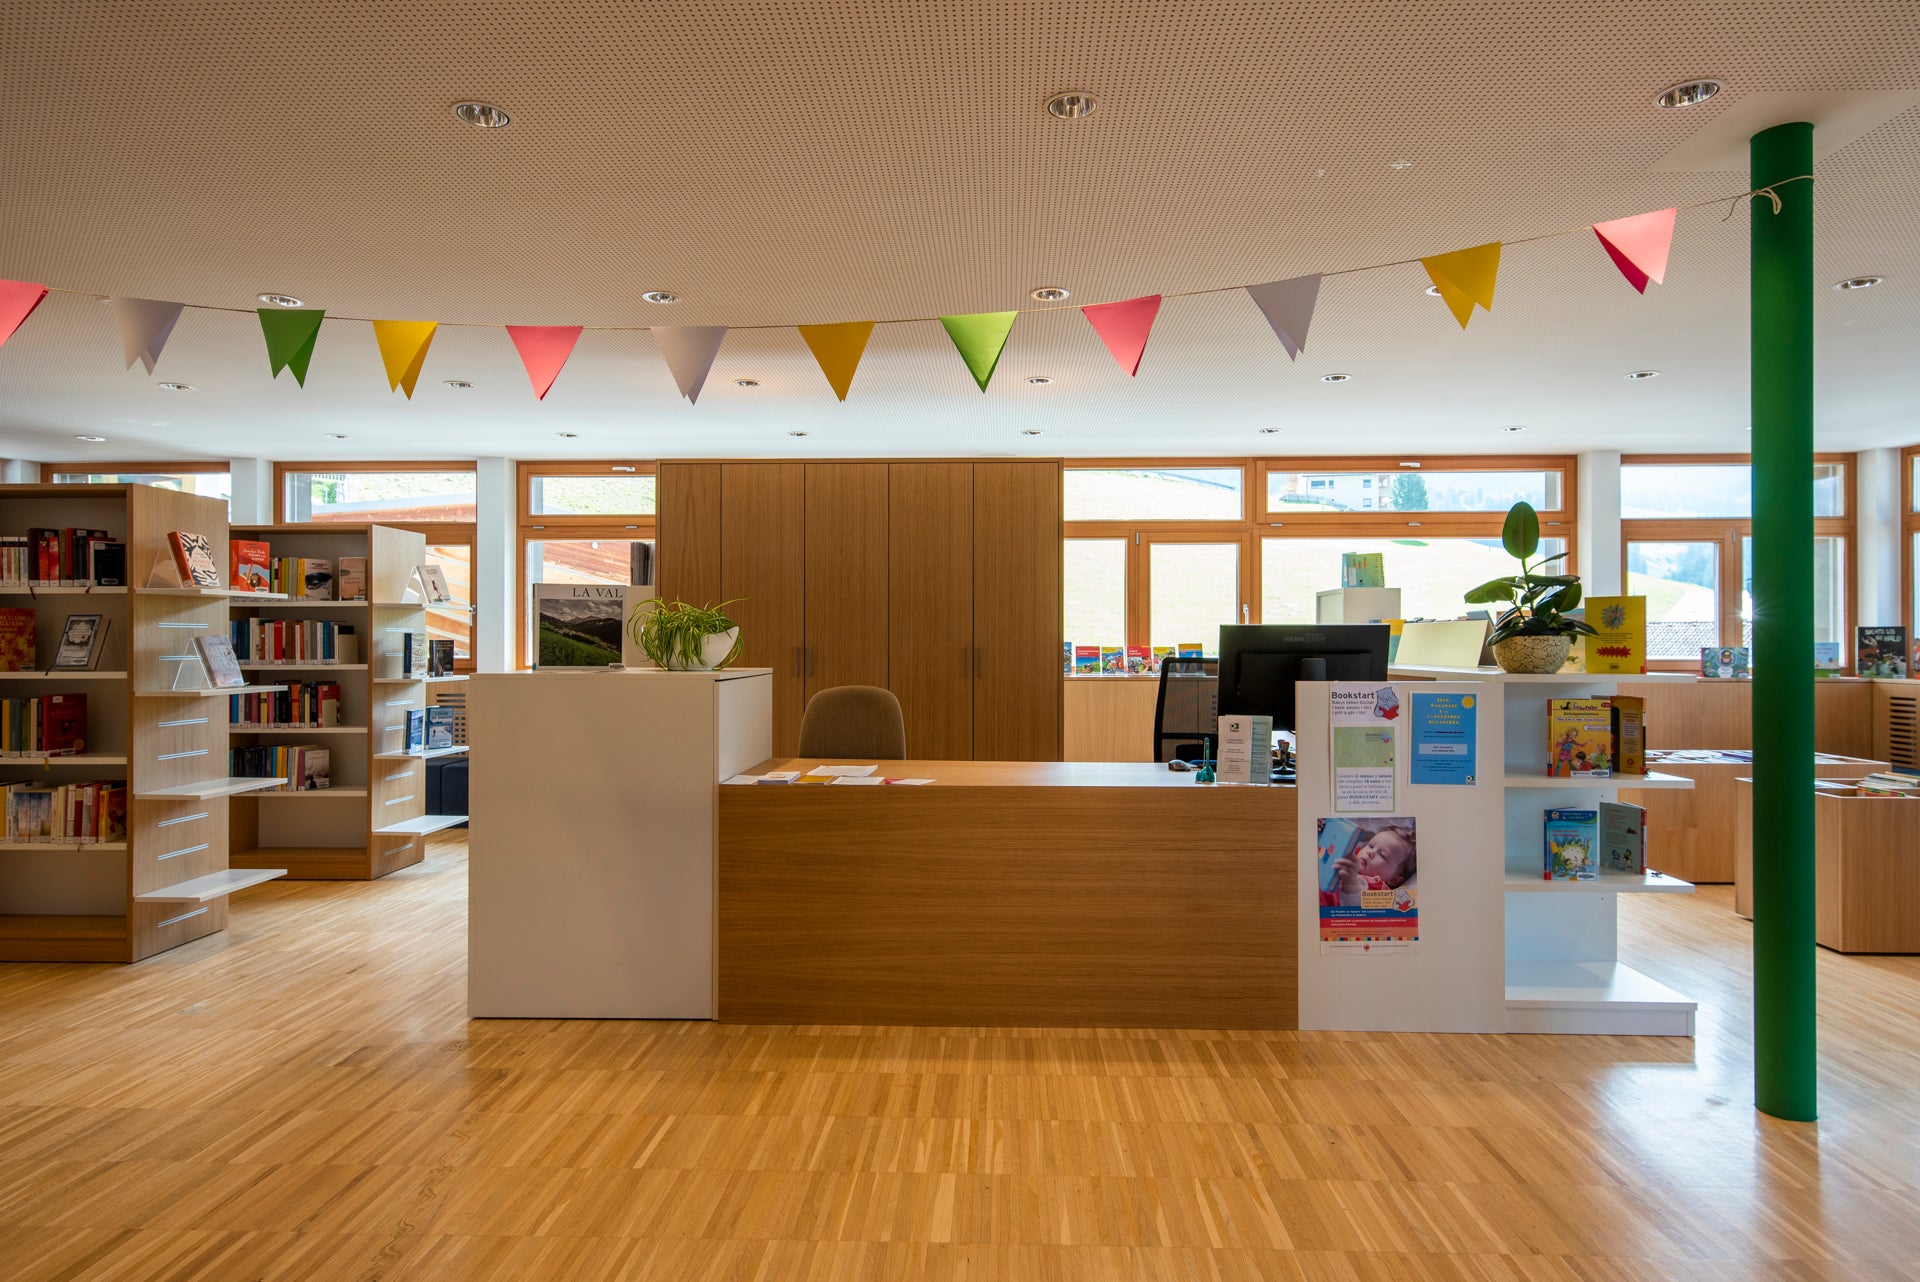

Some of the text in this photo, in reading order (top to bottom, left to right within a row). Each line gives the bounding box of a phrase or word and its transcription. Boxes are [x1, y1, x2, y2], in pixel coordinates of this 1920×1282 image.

[572, 587, 623, 598] LA VAL
[1331, 691, 1375, 699] Bookstart
